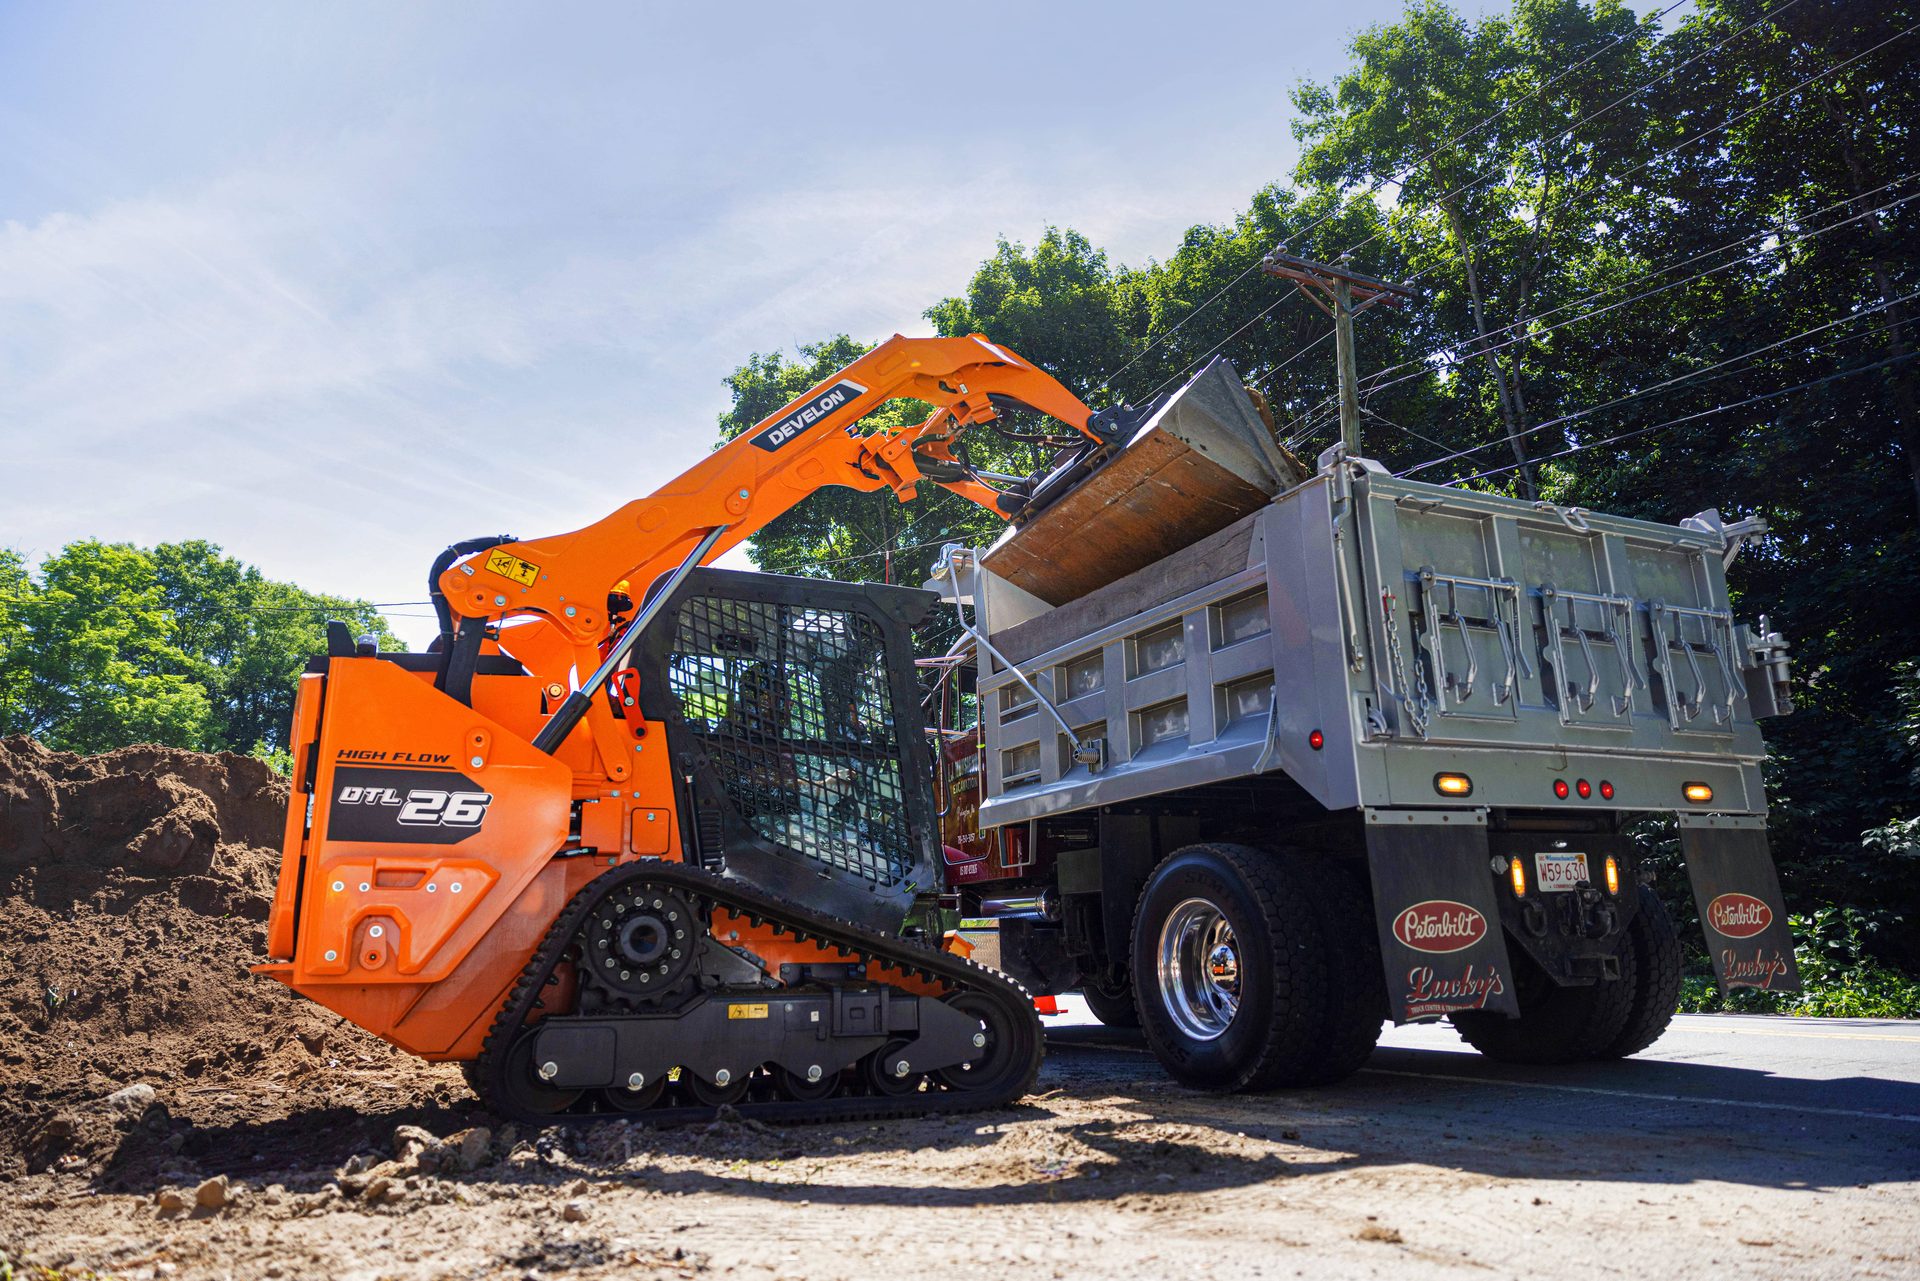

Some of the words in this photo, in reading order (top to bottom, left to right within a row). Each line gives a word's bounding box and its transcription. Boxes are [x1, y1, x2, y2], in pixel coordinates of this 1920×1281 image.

[768, 390, 846, 446] DEVELON
[337, 749, 387, 761] HIGH
[392, 752, 451, 763] FLOW
[338, 786, 402, 806] DTL
[397, 789, 494, 828] 26
[1404, 911, 1480, 942] Peterbilt
[1713, 902, 1766, 929] Peterbilt
[1405, 964, 1504, 1009] Lucky's
[1722, 948, 1788, 989] Lucky's
